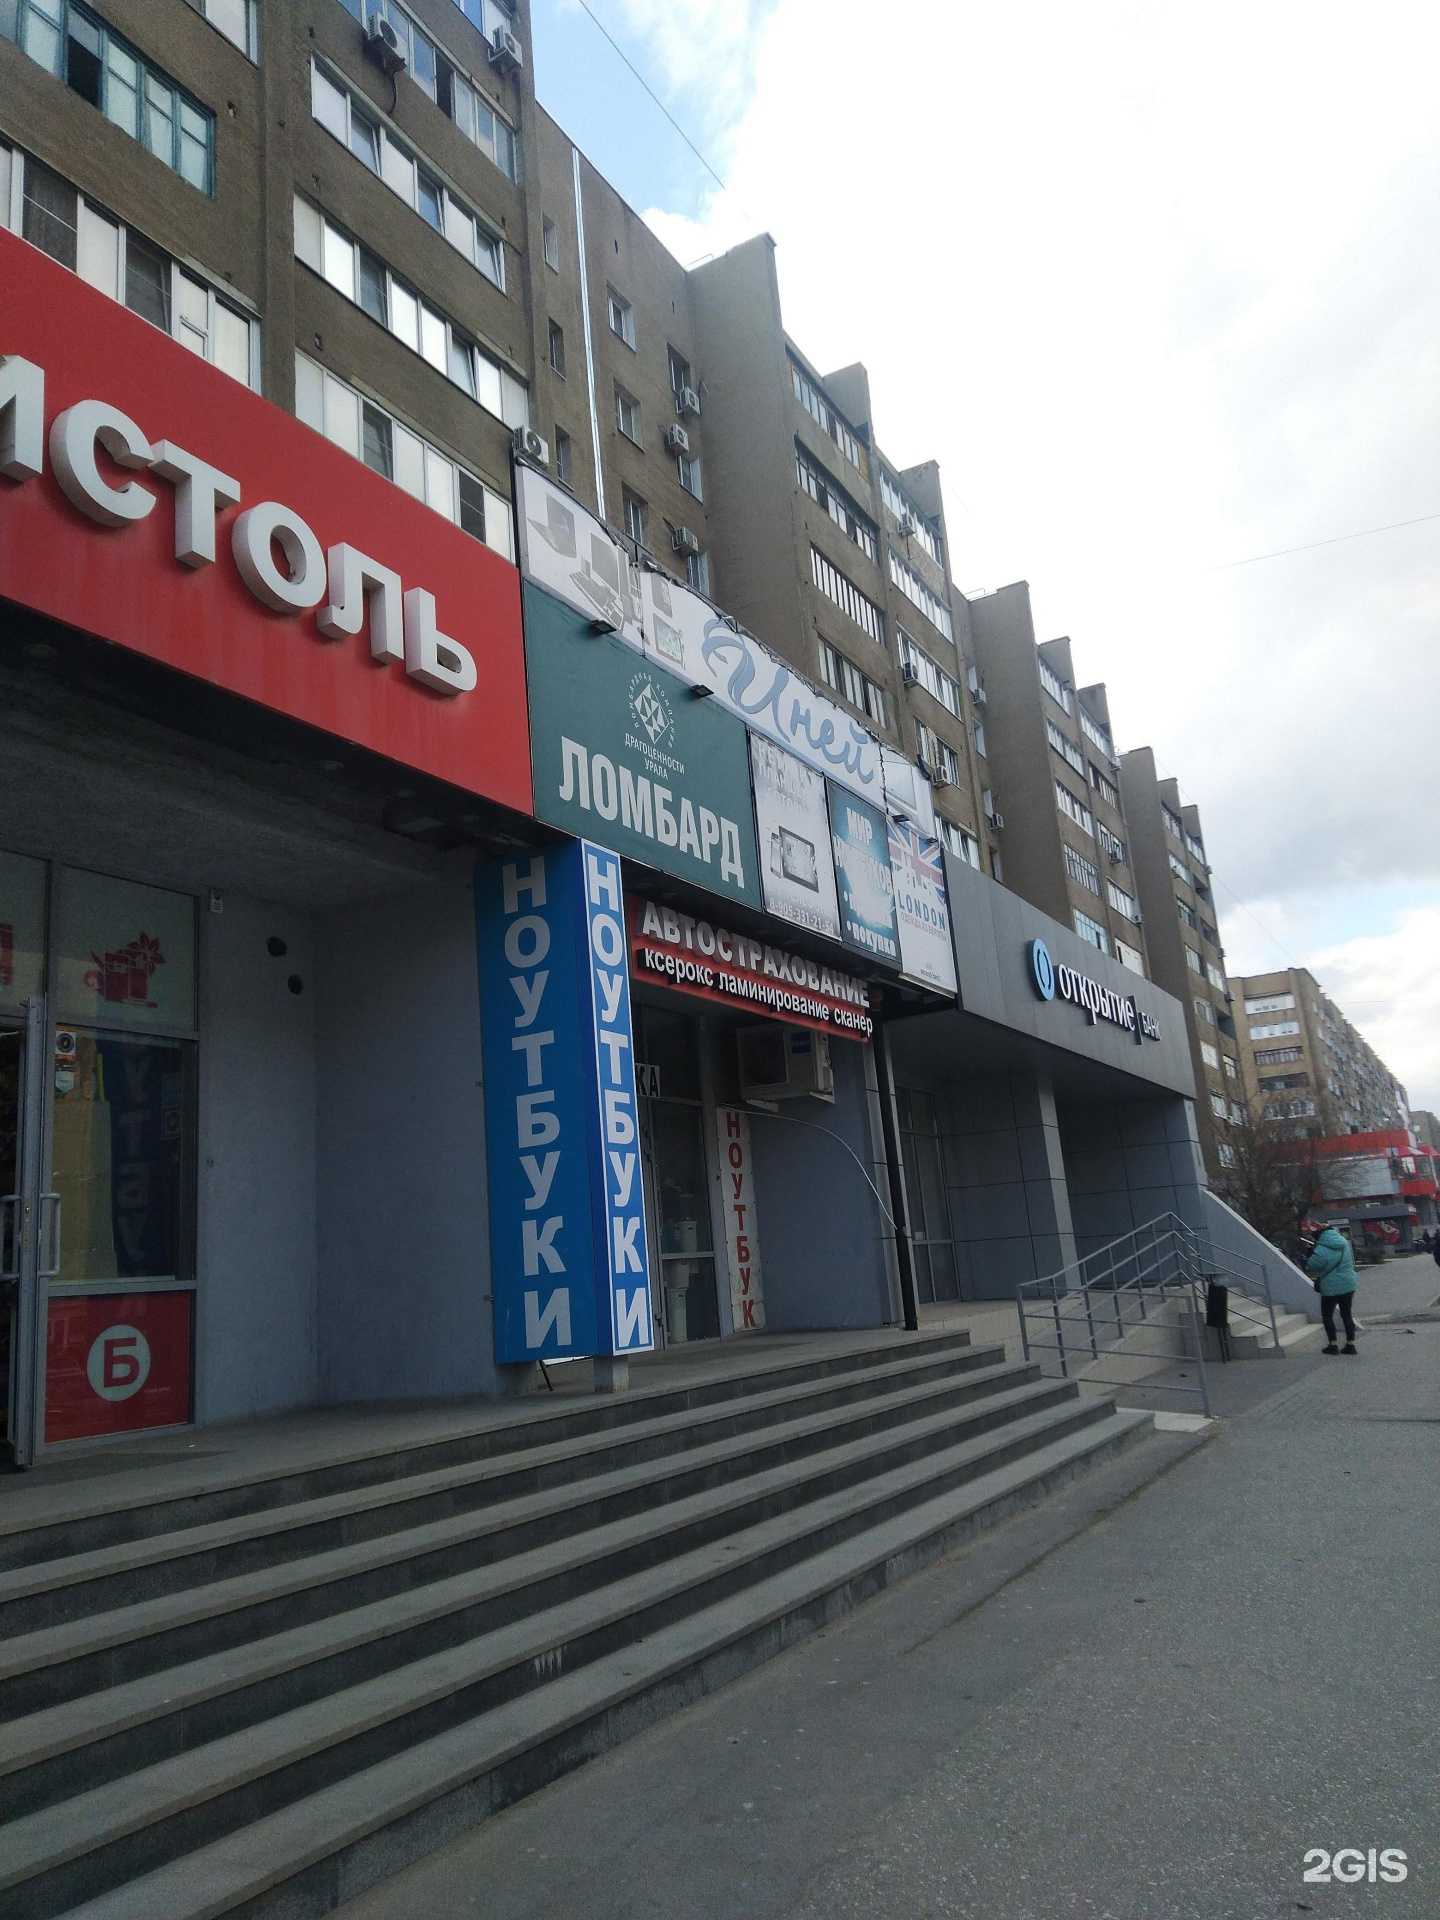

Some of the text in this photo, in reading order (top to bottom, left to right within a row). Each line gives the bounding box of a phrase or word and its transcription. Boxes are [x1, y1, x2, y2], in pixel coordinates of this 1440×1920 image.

[625, 733, 685, 775] ДРАГОЦЕННОСТИ
[645, 758, 668, 780] УРАЛА
[559, 736, 745, 888] ЛОМБАРД
[643, 901, 870, 1008] АВТОСТРАХОВАНИЕ
[898, 888, 946, 931] LONDON
[646, 948, 873, 1037] ксерокс ламинирование сканер
[502, 857, 572, 1349] НОУТБУКИ
[586, 852, 651, 1348] НОУТБУКИ
[726, 1111, 756, 1328] НОУТБУК
[102, 1336, 140, 1389] Б
